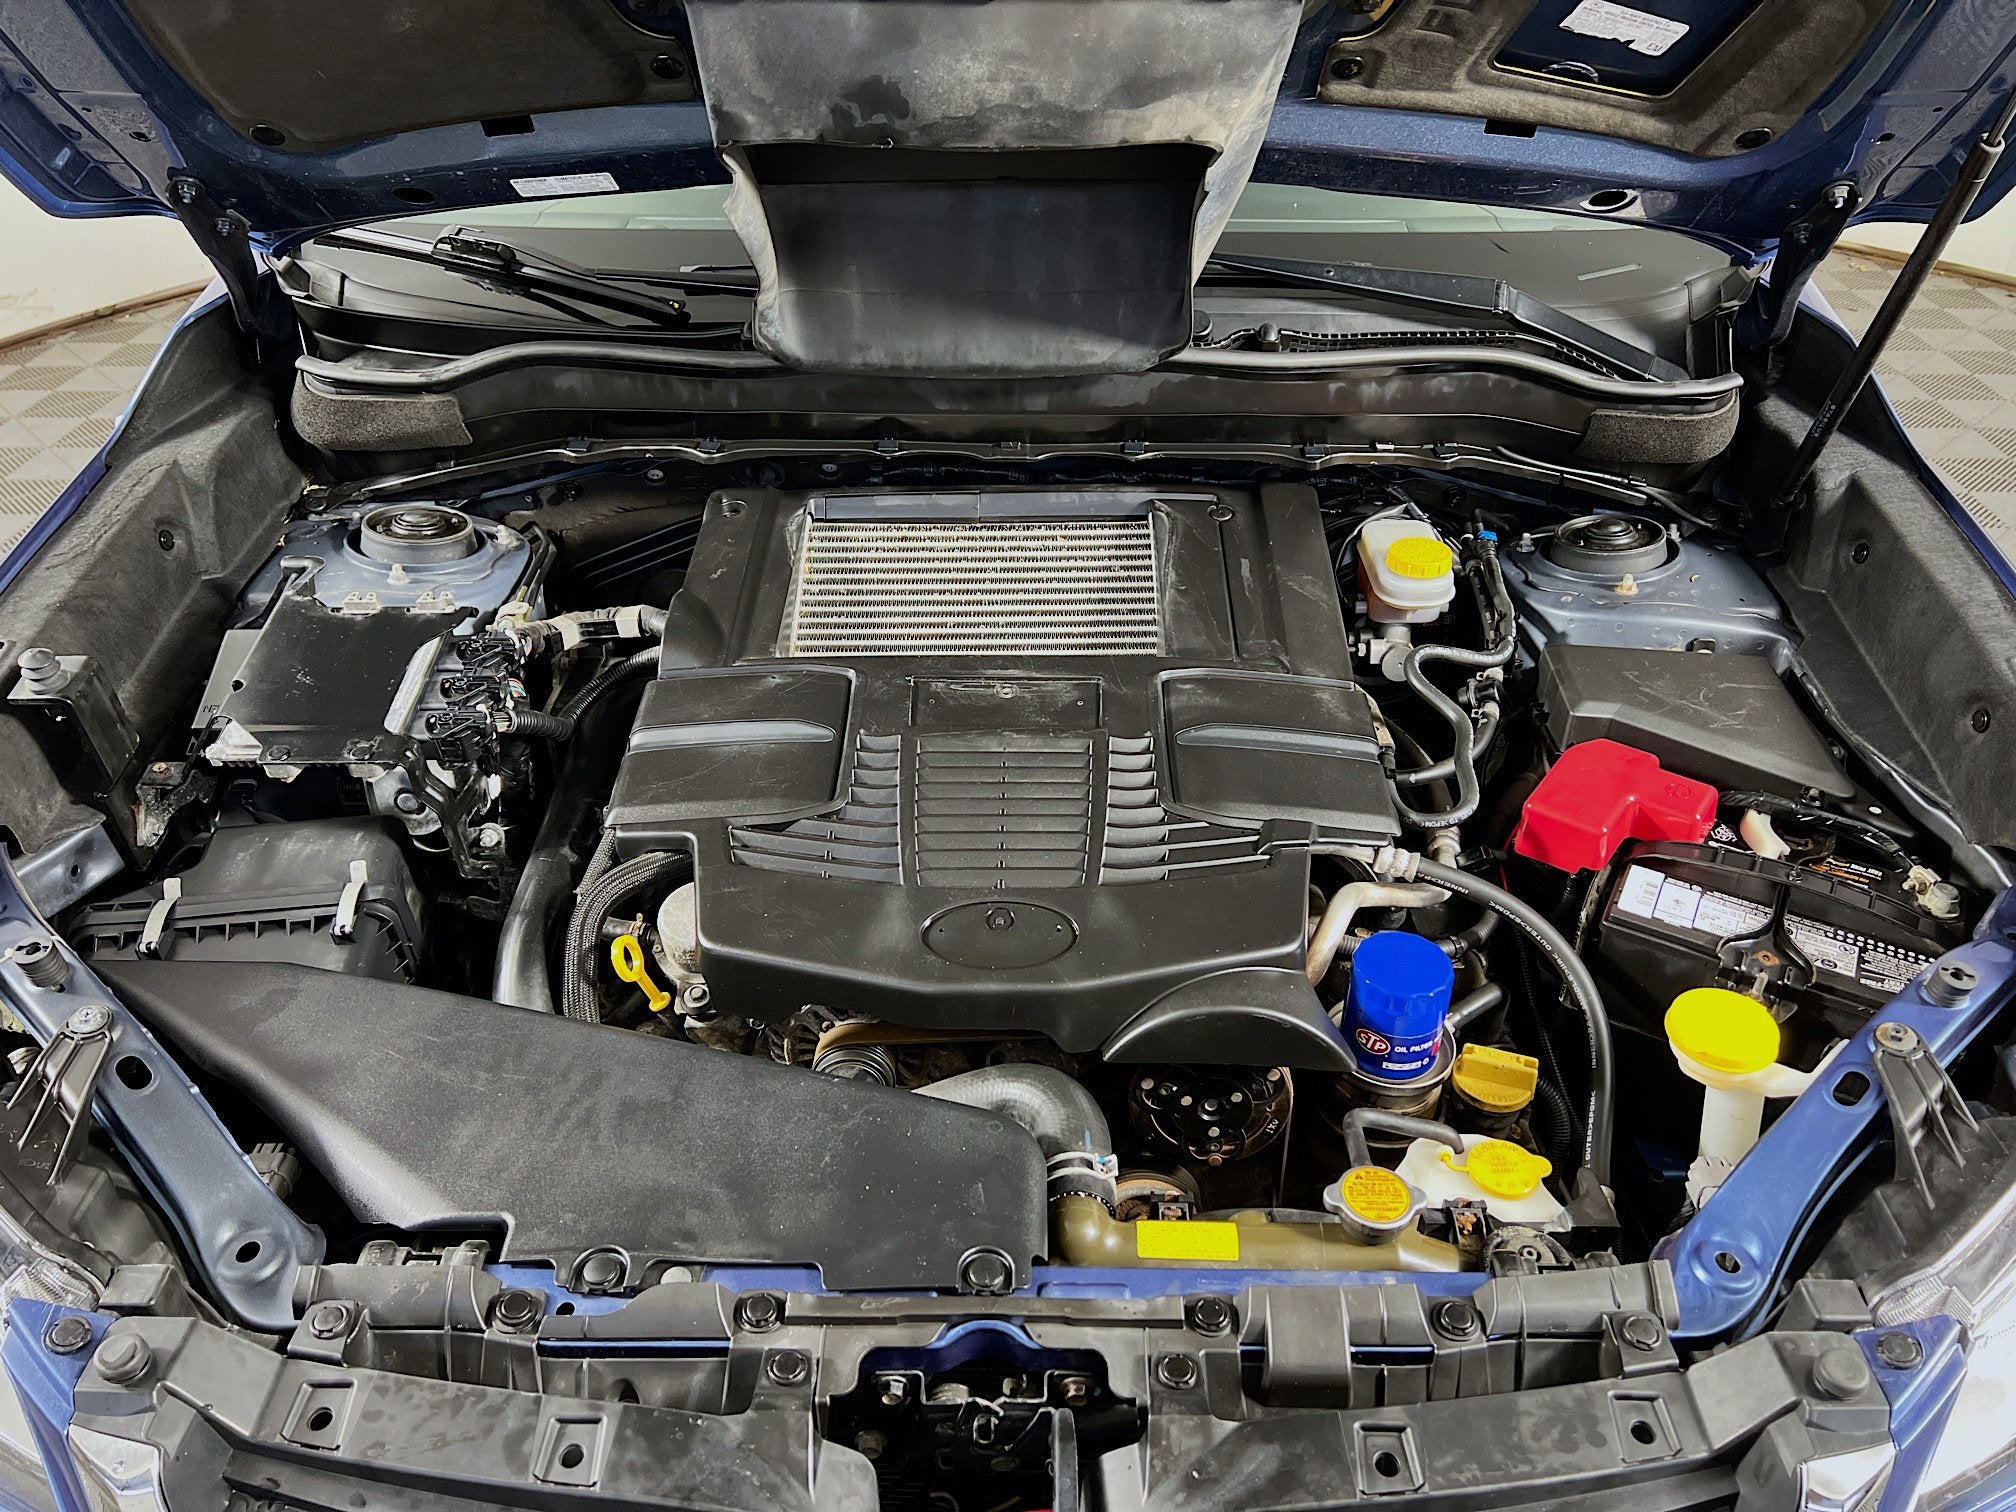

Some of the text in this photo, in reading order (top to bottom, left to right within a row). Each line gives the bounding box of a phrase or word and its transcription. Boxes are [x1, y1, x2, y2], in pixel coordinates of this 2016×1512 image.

[1358, 1031, 1388, 1051] STP
[1394, 1040, 1434, 1054] OIL FILTER
